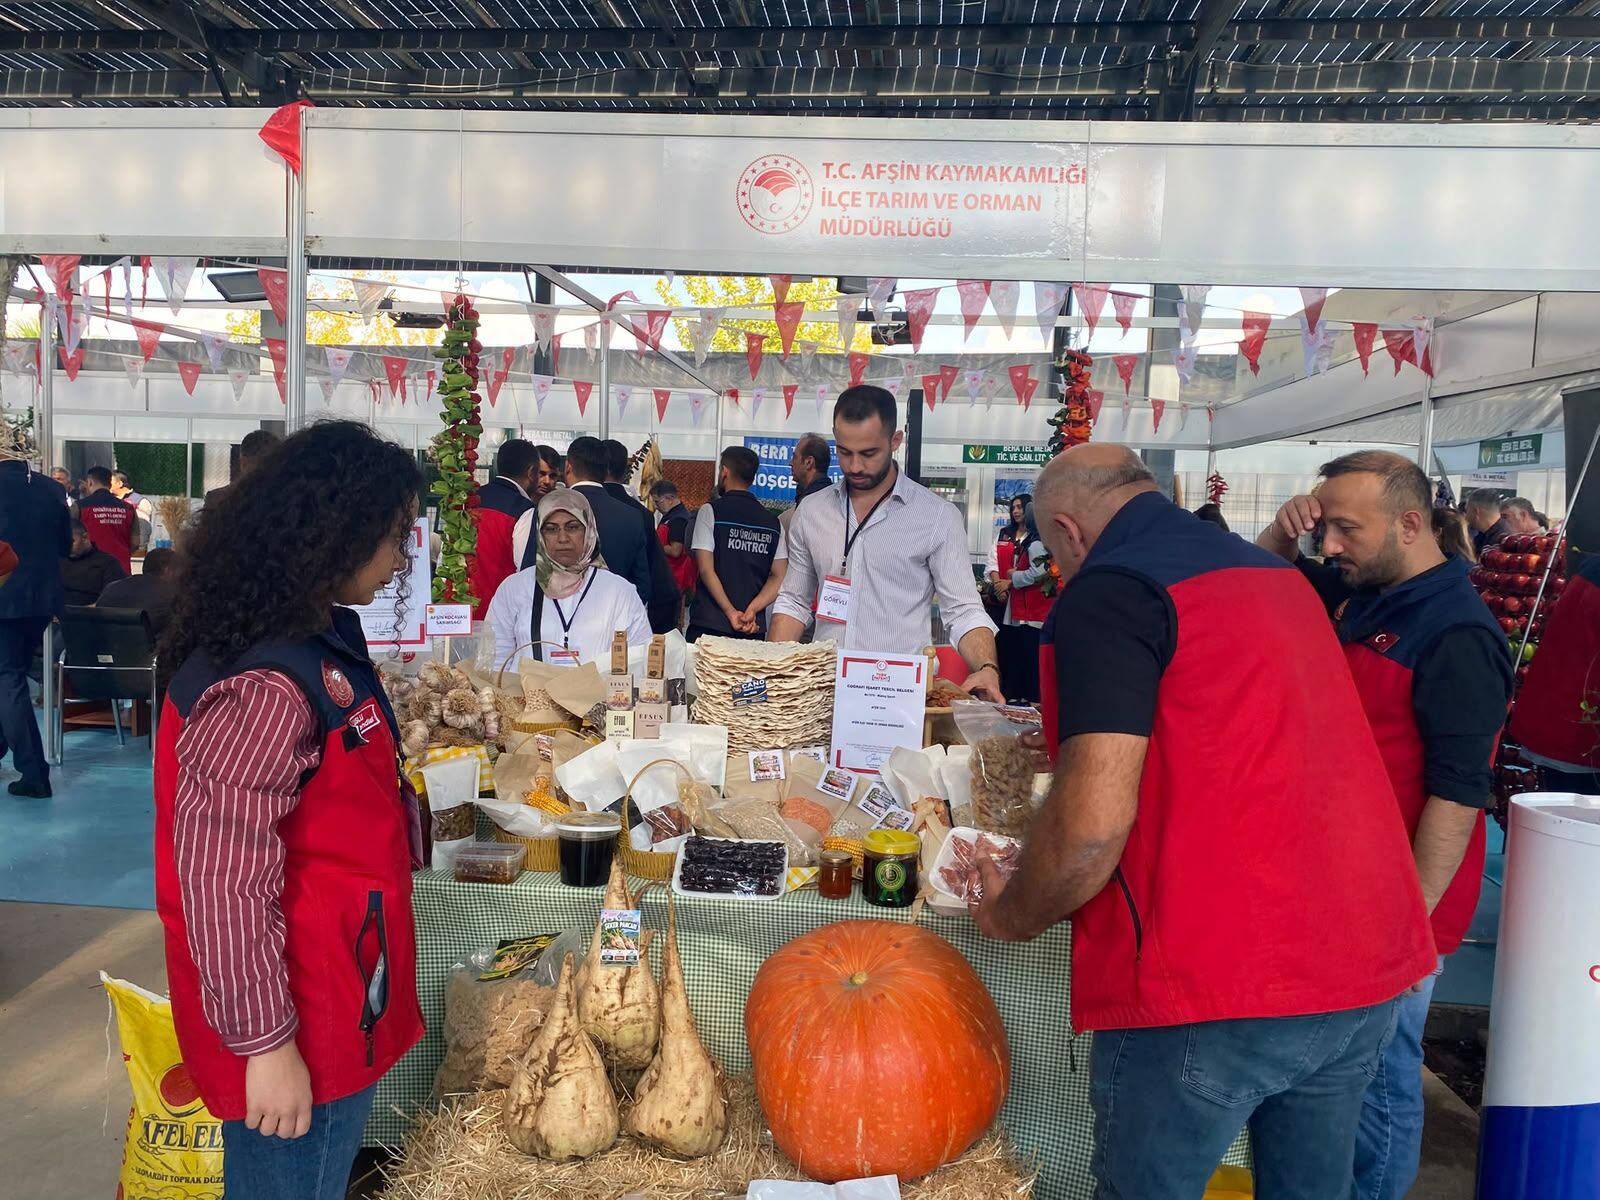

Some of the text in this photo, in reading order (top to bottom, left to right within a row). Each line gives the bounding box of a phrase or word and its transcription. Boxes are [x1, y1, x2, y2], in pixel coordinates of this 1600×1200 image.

[822, 161, 1087, 185] T.C. AFŞİN KAYMAKAMLIĞI
[821, 188, 1042, 212] İLÇE TARIM VE ORMAN
[820, 216, 953, 238] MÜDÜRLÜĞÜ
[750, 443, 788, 460] BERA
[1009, 453, 1018, 461] VE
[729, 528, 772, 544] SU ÜRÜNLERİ
[728, 538, 769, 554] KONTROL
[193, 1124, 224, 1149] EL
[170, 1176, 202, 1184] TOPRAK
